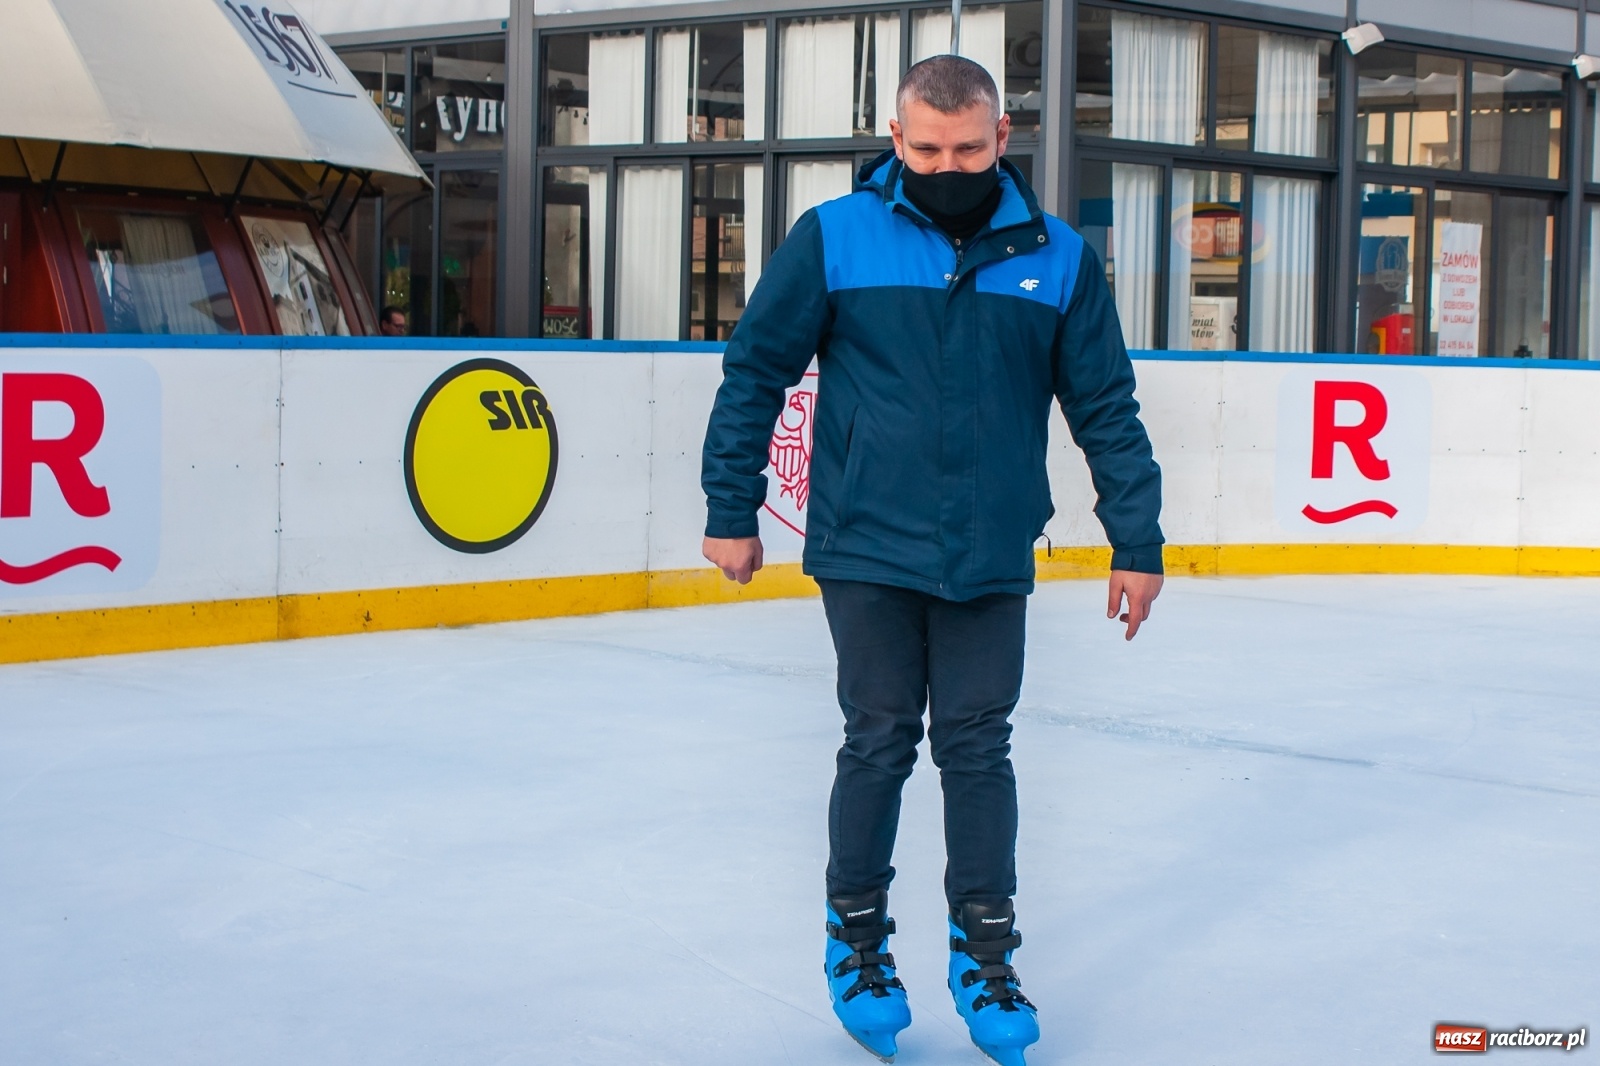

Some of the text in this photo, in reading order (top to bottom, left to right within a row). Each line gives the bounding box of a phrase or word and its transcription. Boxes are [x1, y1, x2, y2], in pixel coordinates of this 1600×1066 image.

[224, 0, 338, 83] 1567
[1442, 250, 1478, 269] ZAMÓW
[1019, 278, 1040, 291] 4F
[1452, 287, 1465, 297] LUB
[543, 317, 578, 335] WOŚĆ
[1191, 310, 1214, 327] wiat
[480, 388, 549, 431] SIR
[1311, 380, 1391, 481] R
[1, 373, 111, 518] R
